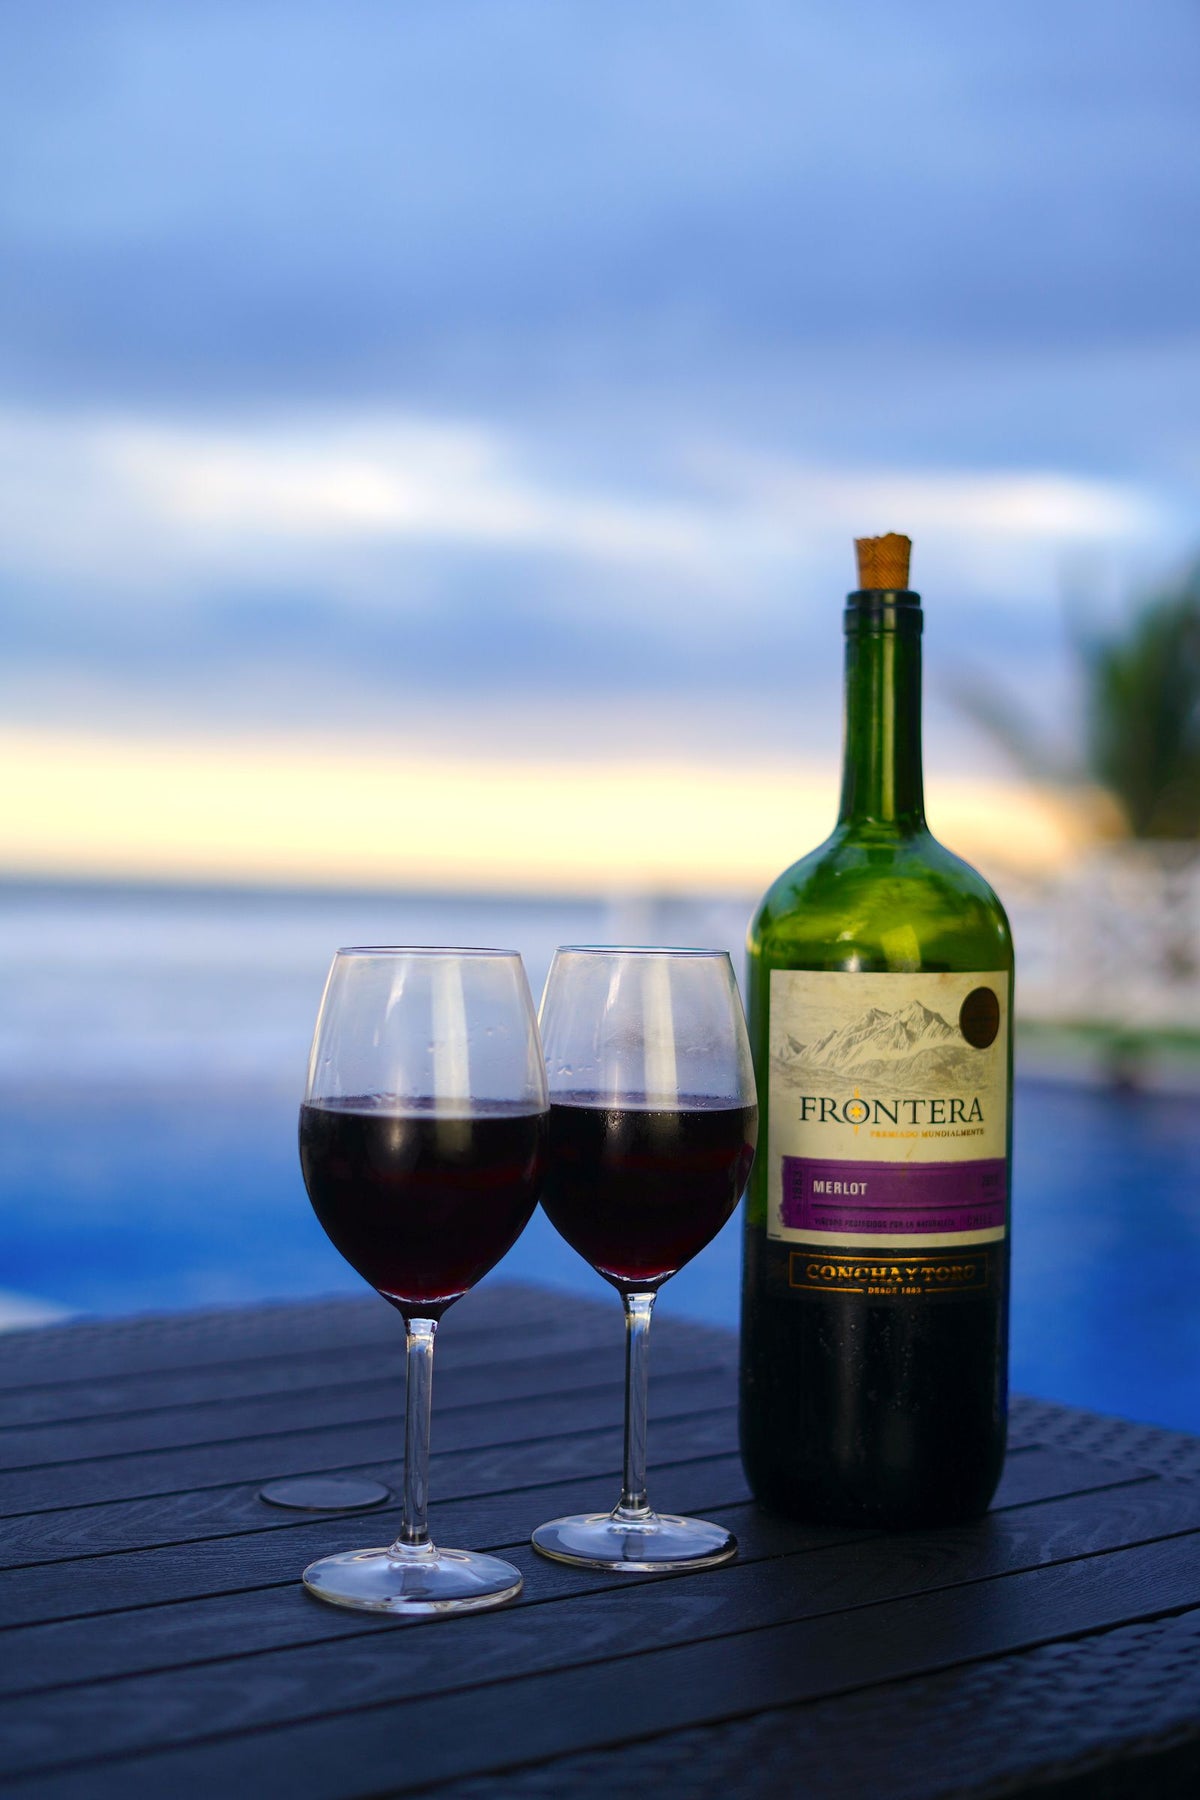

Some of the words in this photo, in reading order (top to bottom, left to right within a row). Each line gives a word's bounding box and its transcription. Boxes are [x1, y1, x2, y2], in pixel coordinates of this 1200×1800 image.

[798, 1096, 984, 1125] FRONTERA
[870, 1130, 918, 1138] PREMIADO
[921, 1128, 985, 1138] MUNDIALMENTE
[813, 1180, 868, 1195] MERLOT
[805, 1263, 903, 1283] CONCHA
[904, 1267, 918, 1282] Y
[919, 1264, 977, 1282] TORO
